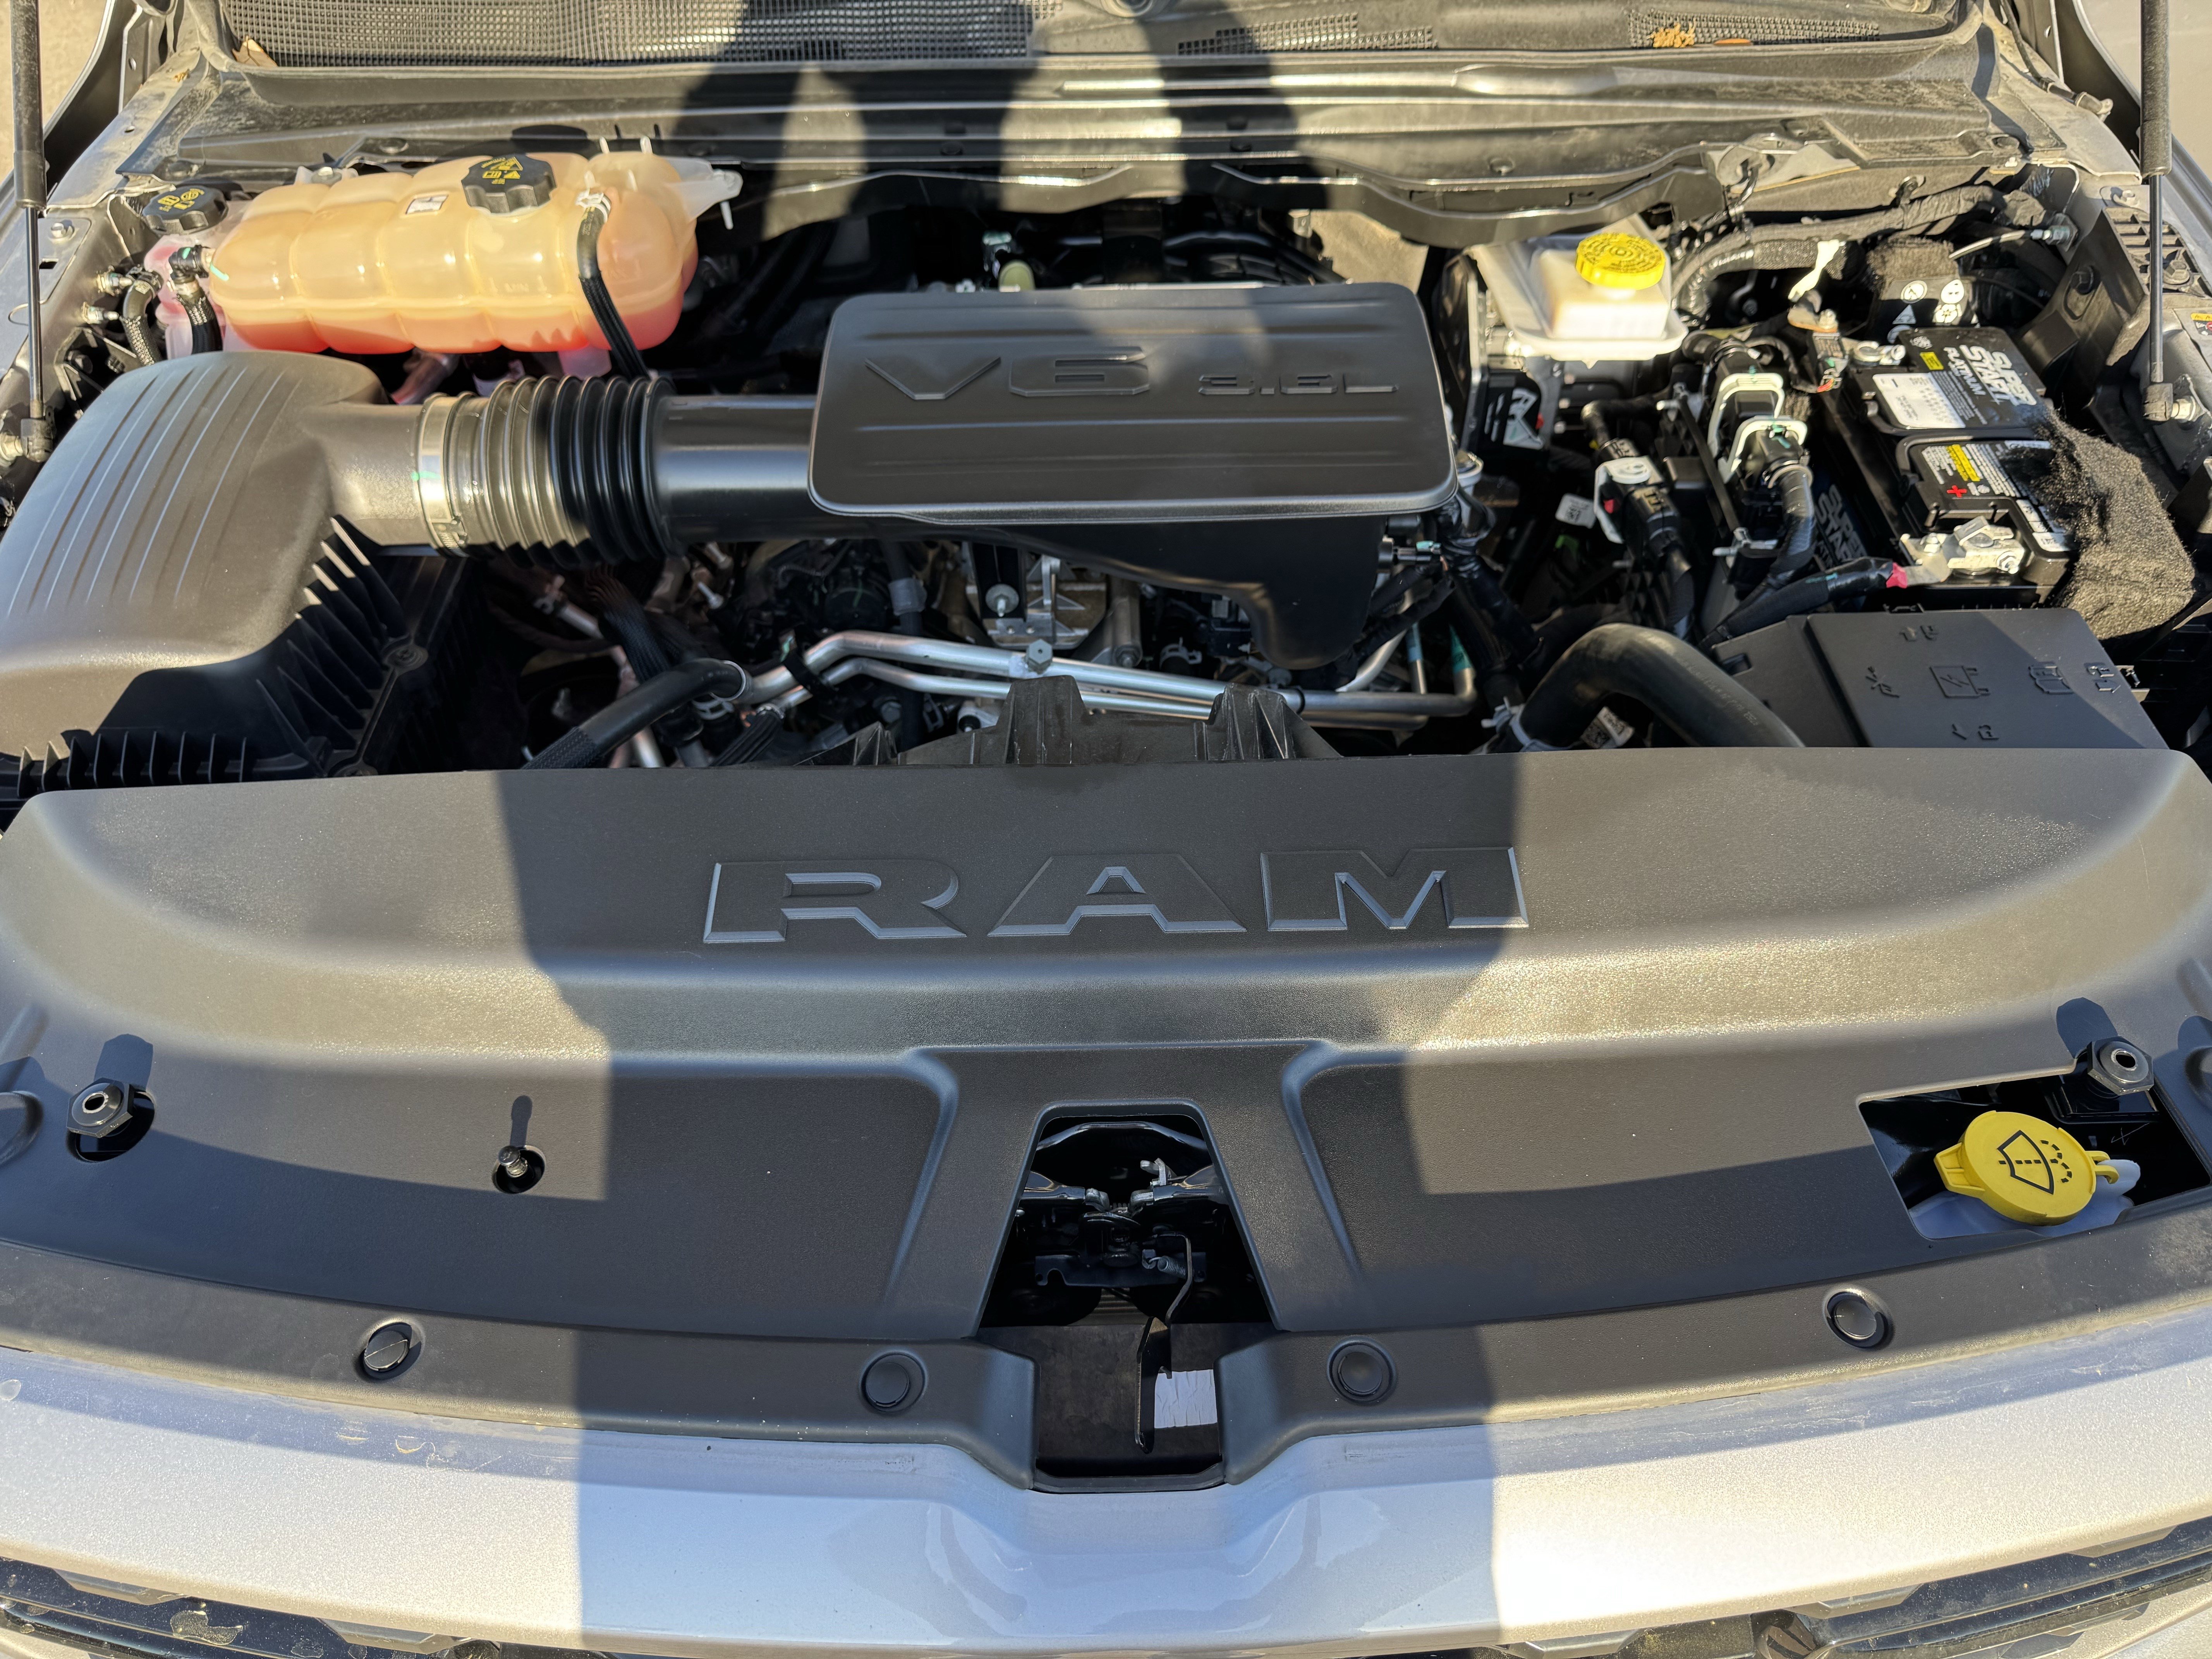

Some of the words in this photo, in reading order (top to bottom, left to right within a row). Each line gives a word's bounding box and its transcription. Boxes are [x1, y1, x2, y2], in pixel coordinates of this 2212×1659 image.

[864, 346, 1149, 400] V6
[1198, 371, 1399, 396] 3.6L
[1943, 347, 1986, 395] PLATINUM
[1959, 344, 2019, 407] START
[1992, 351, 2037, 405] SUPER
[1814, 492, 1853, 560] STAR
[702, 846, 1531, 943] RAM
